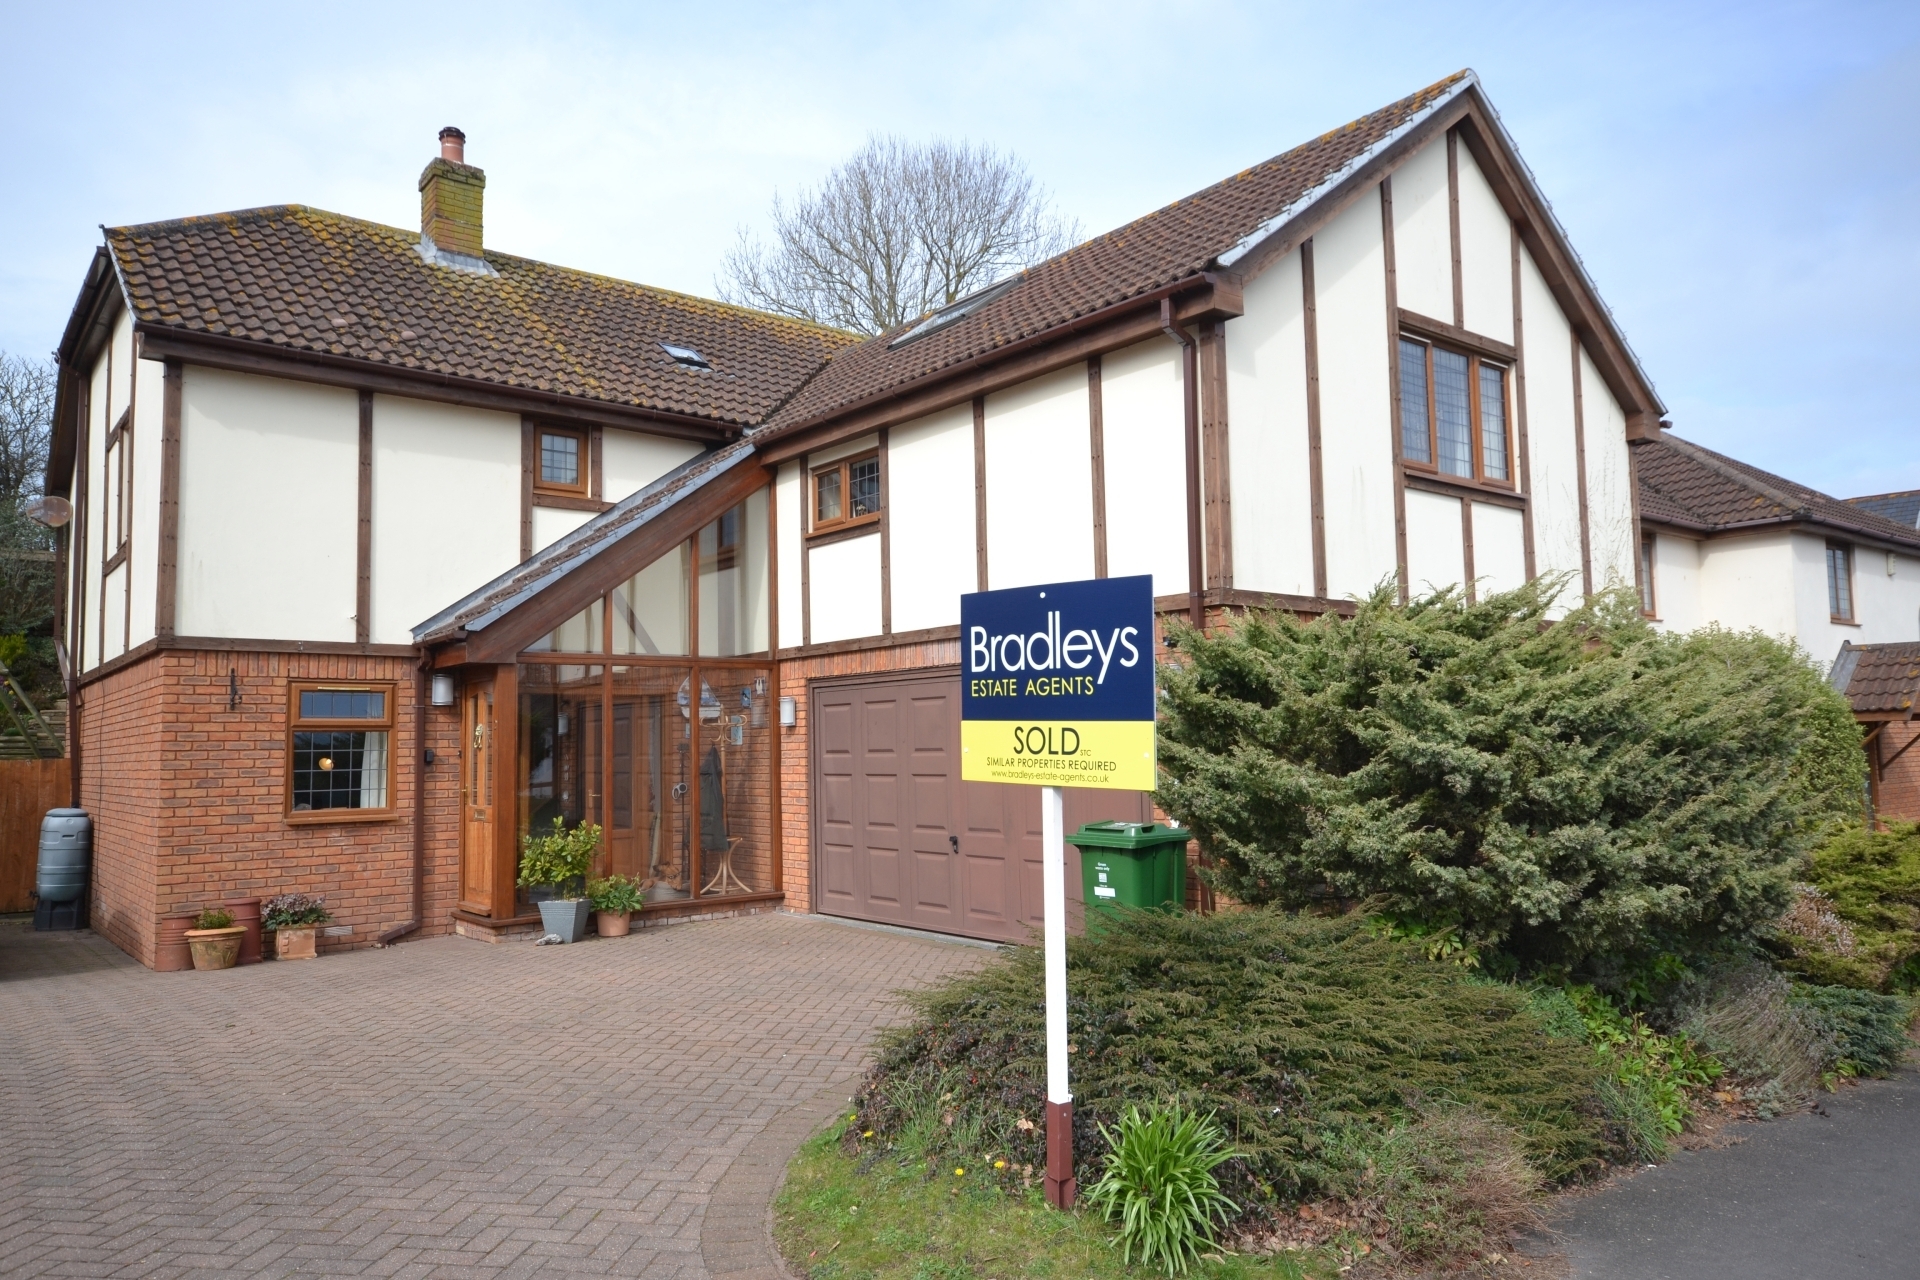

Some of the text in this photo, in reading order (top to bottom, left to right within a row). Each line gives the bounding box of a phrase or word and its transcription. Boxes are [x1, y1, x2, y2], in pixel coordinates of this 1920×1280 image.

[970, 611, 1139, 685] Bradleys
[971, 676, 1094, 697] ESTATE AGENTS
[1013, 726, 1092, 757] SOLD STC
[986, 756, 1117, 772] SIMILAR PROPERTIES REQUIRED
[991, 770, 1110, 783] www.bradleys-estate-agents.co.uk
